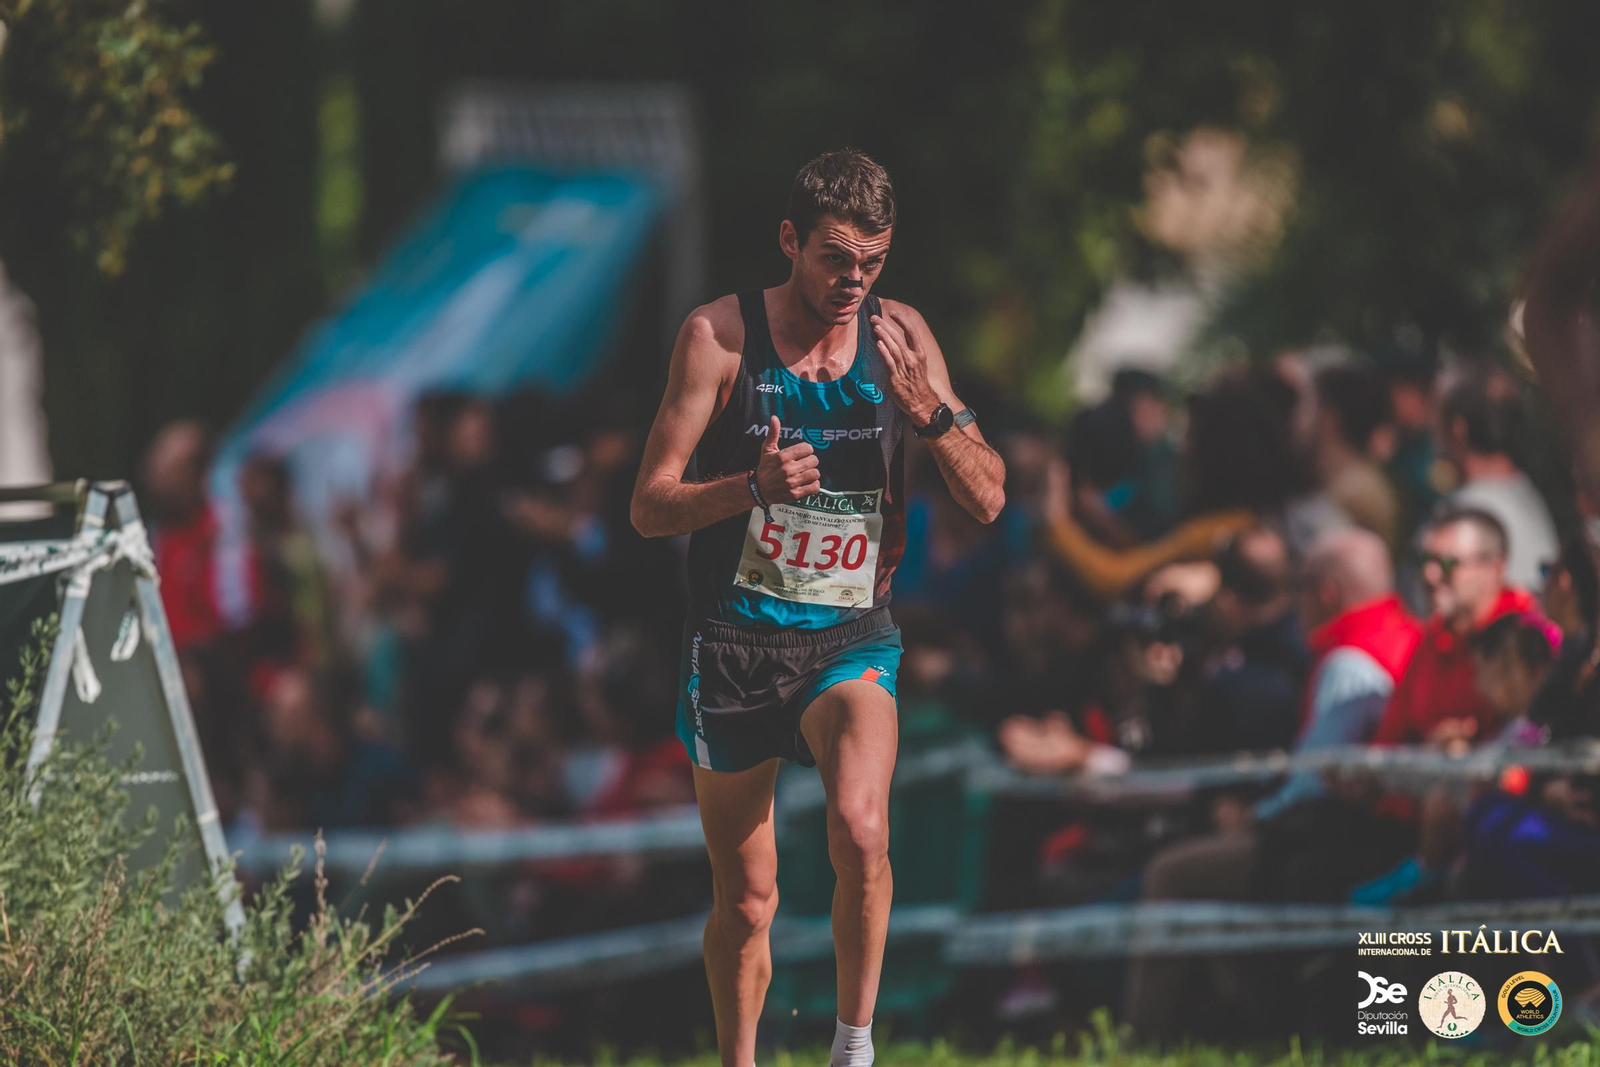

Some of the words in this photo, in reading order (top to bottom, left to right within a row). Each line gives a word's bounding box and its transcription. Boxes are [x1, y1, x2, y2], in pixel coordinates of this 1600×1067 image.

[756, 383, 784, 394] 42K
[797, 492, 855, 512] TÁLICA
[777, 507, 812, 520] ALEJANDRO
[812, 514, 845, 524] SANVALERO
[755, 522, 868, 571] 5130
